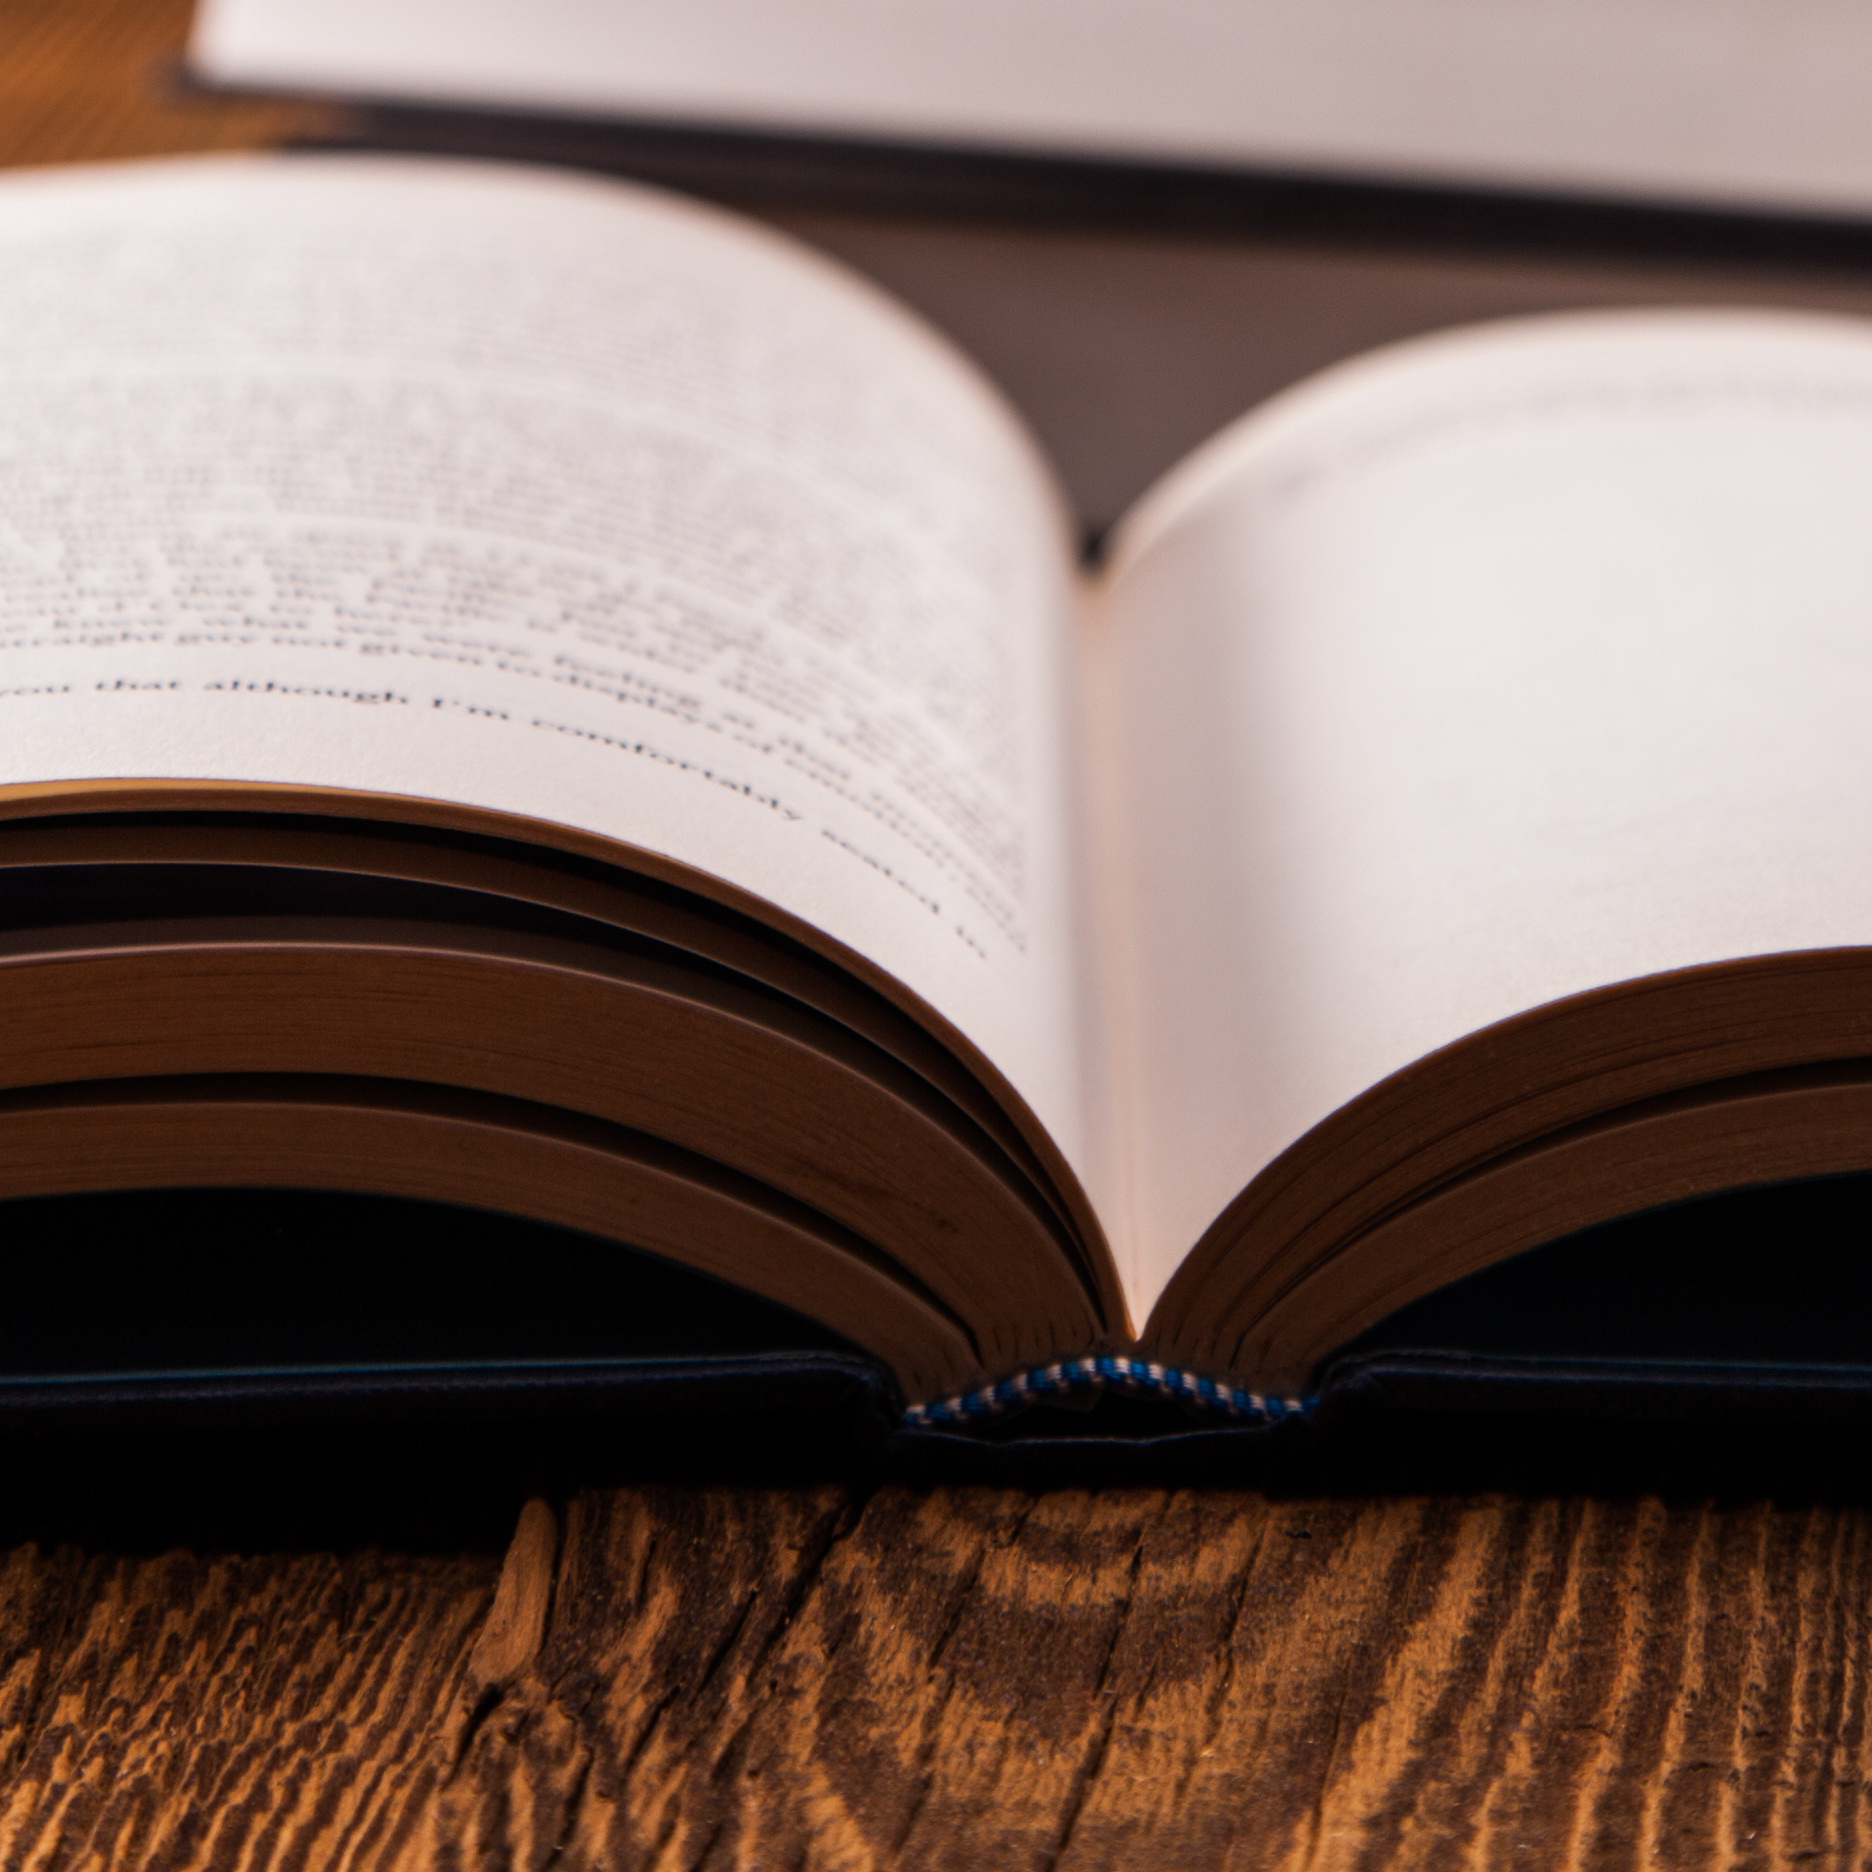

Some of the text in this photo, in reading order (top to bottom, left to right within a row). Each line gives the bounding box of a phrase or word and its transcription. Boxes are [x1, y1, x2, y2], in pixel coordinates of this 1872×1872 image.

[95, 678, 181, 691] that
[204, 679, 408, 705] although
[432, 697, 509, 721] I'm
[531, 719, 801, 821] comfortably
[821, 828, 941, 916] seated
